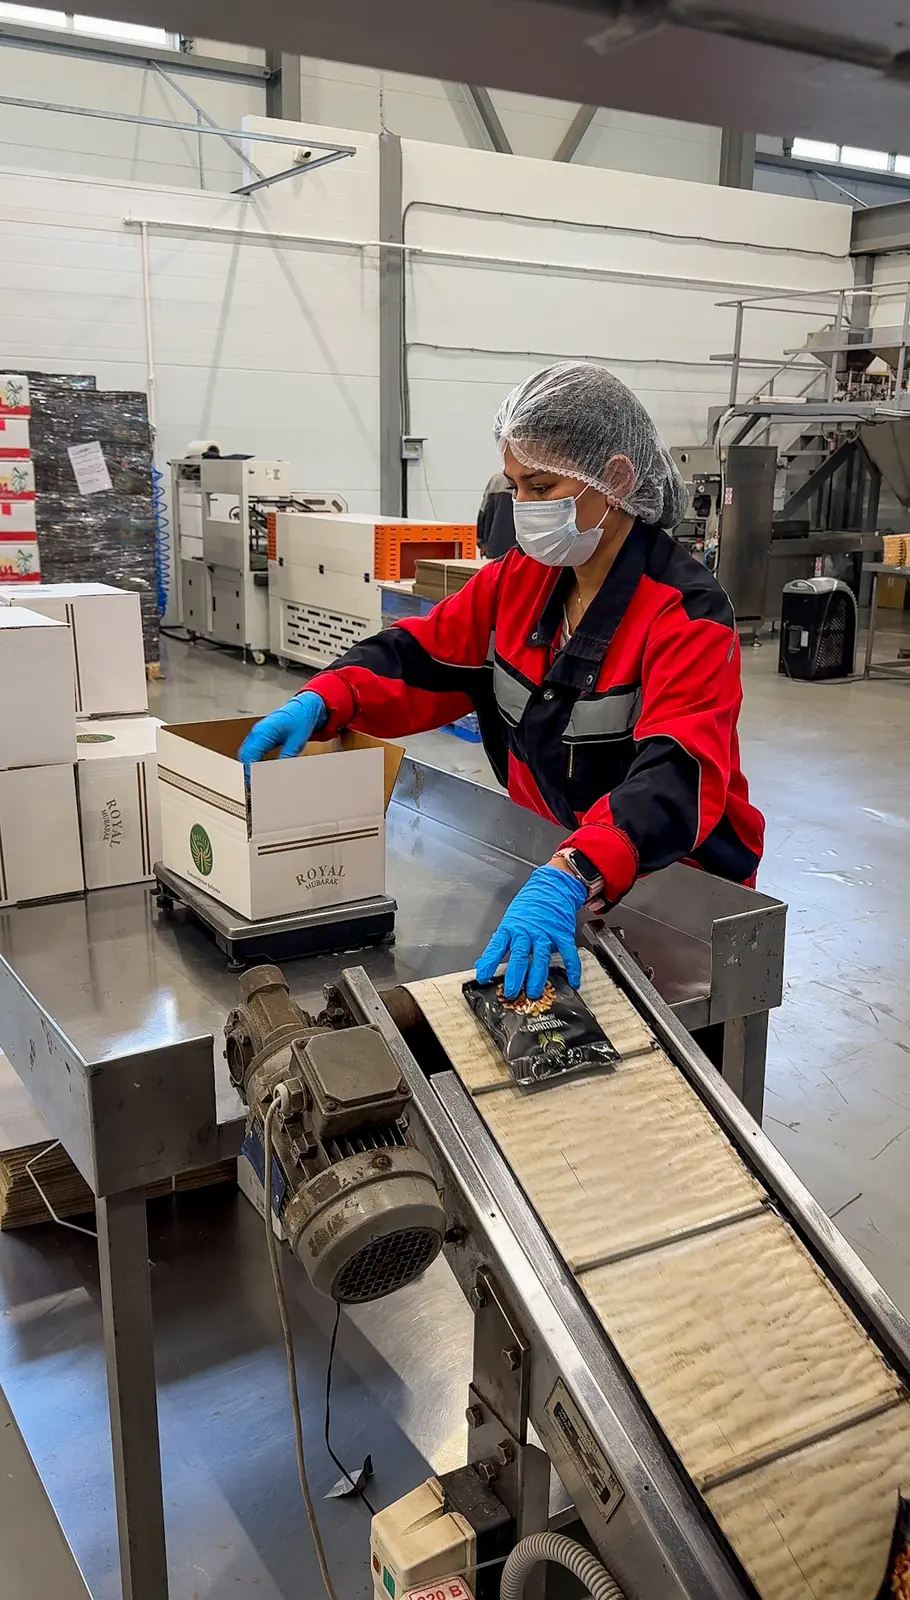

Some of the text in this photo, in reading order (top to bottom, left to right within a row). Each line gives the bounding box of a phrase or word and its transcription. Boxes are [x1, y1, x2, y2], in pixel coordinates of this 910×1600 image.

[106, 799, 123, 848] ROYAL
[295, 865, 346, 886] ROYAL
[305, 879, 338, 891] MUBARAK
[527, 1019, 563, 1032] КЕШЬЮ
[417, 1590, 446, 1600] 20
